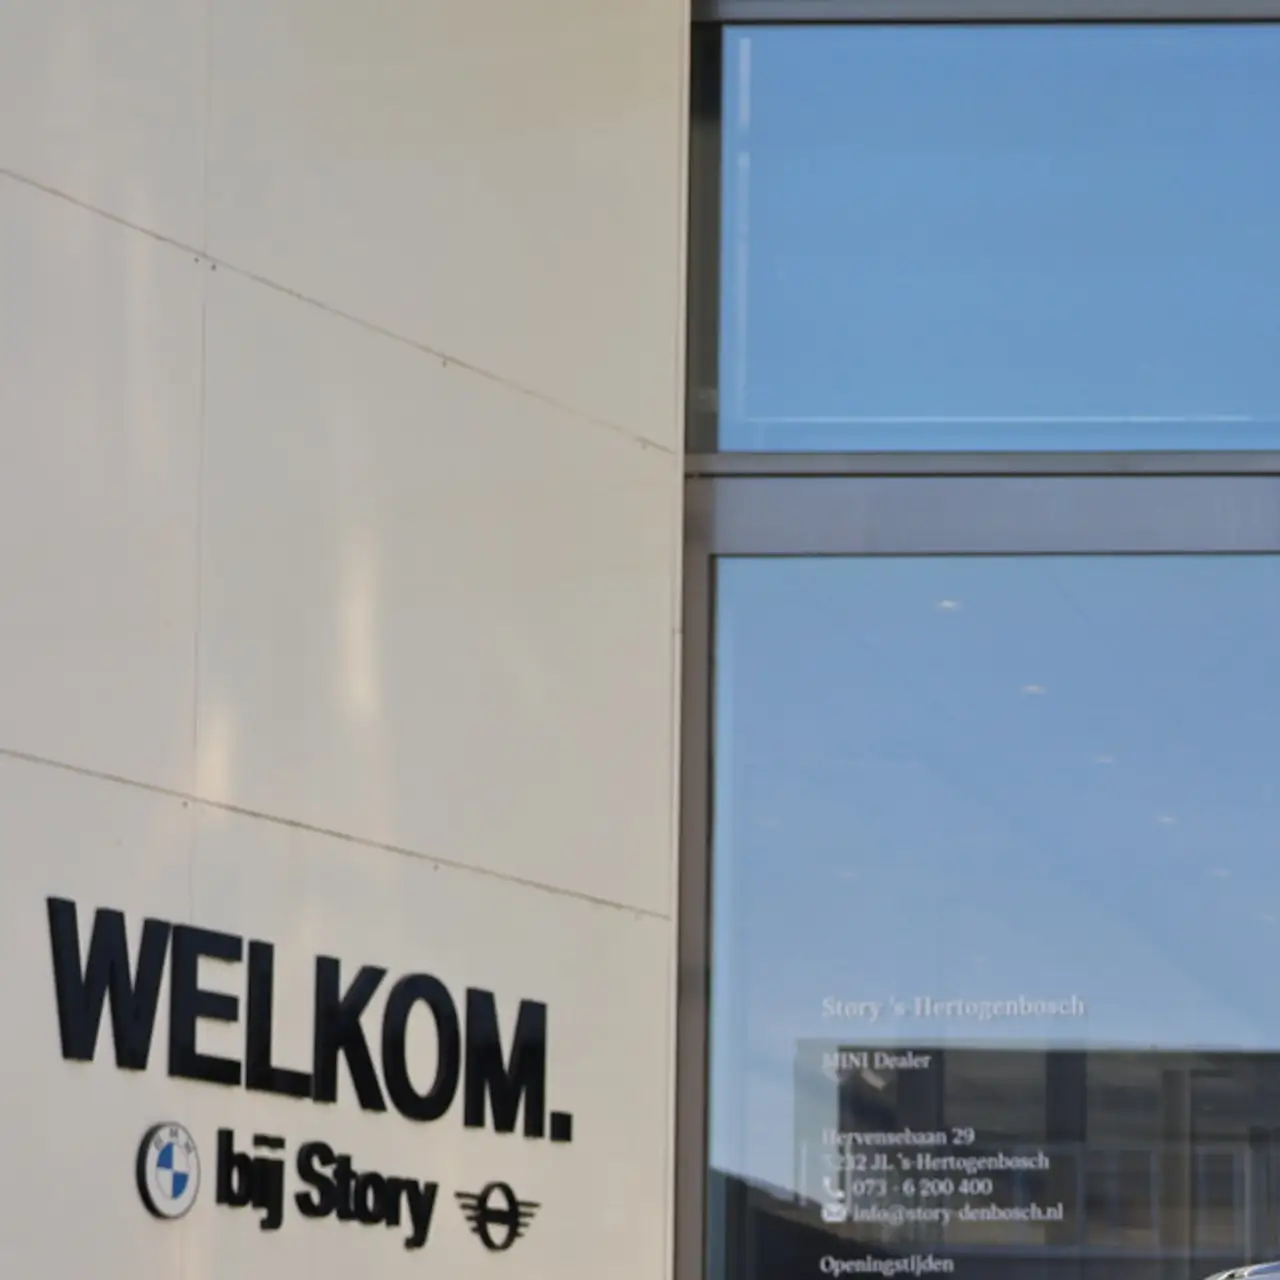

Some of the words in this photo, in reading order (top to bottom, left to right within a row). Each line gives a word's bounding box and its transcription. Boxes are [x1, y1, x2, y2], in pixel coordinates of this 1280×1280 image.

[46, 896, 573, 1142] WELKOM.
[821, 996, 881, 1022] Story
[873, 1050, 932, 1069] Dealer
[821, 1127, 947, 1146] Hervensebaan
[952, 1127, 976, 1145] 29
[870, 1153, 893, 1169] JL
[215, 1127, 285, 1230] bij
[295, 1141, 438, 1249] Story
[852, 1179, 887, 1196] 073
[902, 1178, 916, 1195] 6
[919, 1178, 954, 1195] 200
[957, 1178, 993, 1195] 400
[819, 1255, 954, 1276] Openingstijden
